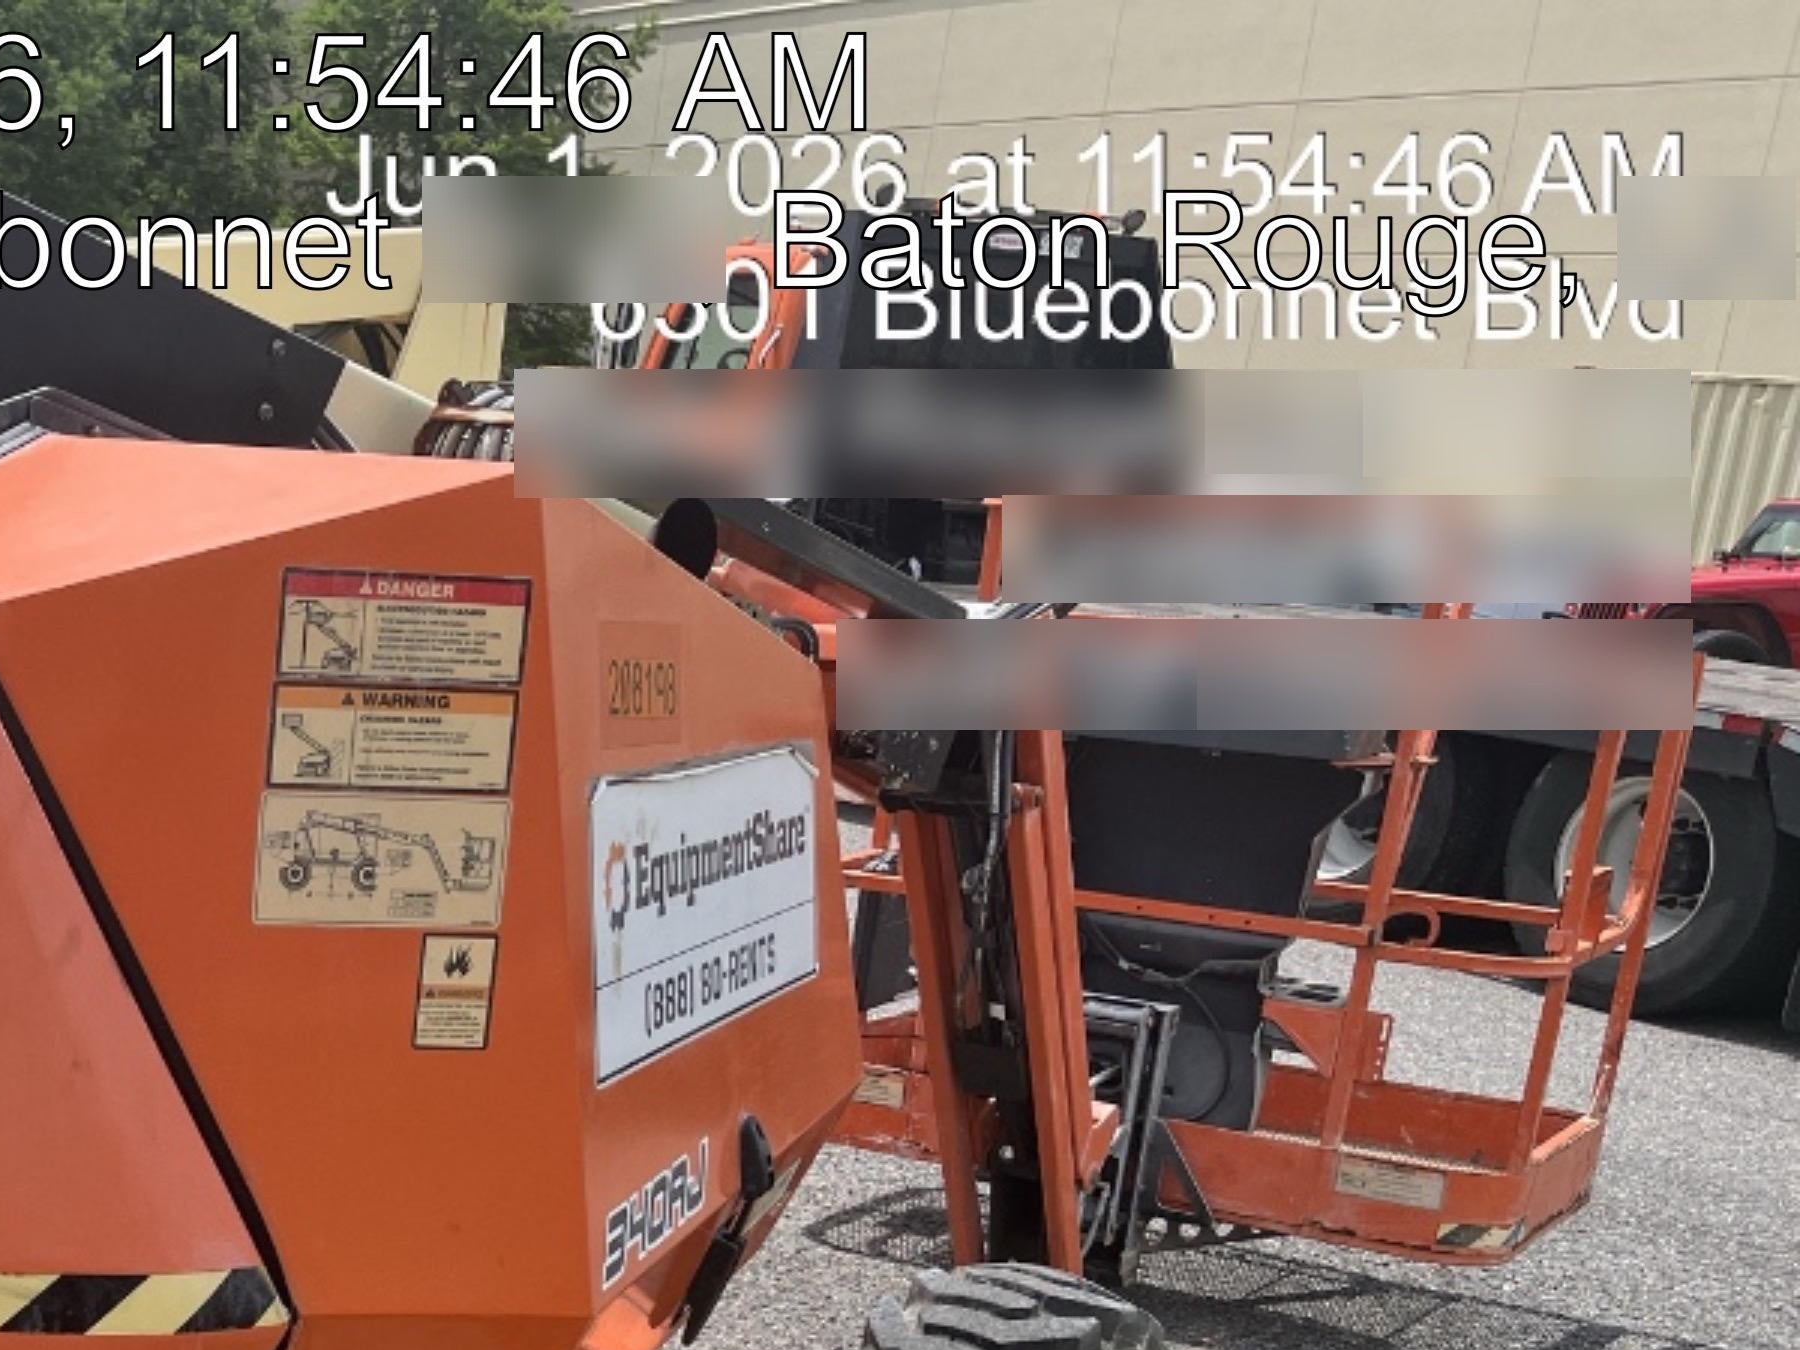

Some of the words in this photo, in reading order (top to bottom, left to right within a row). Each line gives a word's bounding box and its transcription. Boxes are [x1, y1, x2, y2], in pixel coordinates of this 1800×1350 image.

[377, 581, 455, 599] DANGER
[362, 692, 450, 709] WARNING
[608, 658, 676, 716] 208198
[633, 809, 805, 917] EquipmentShare
[645, 954, 695, 1028] (888)
